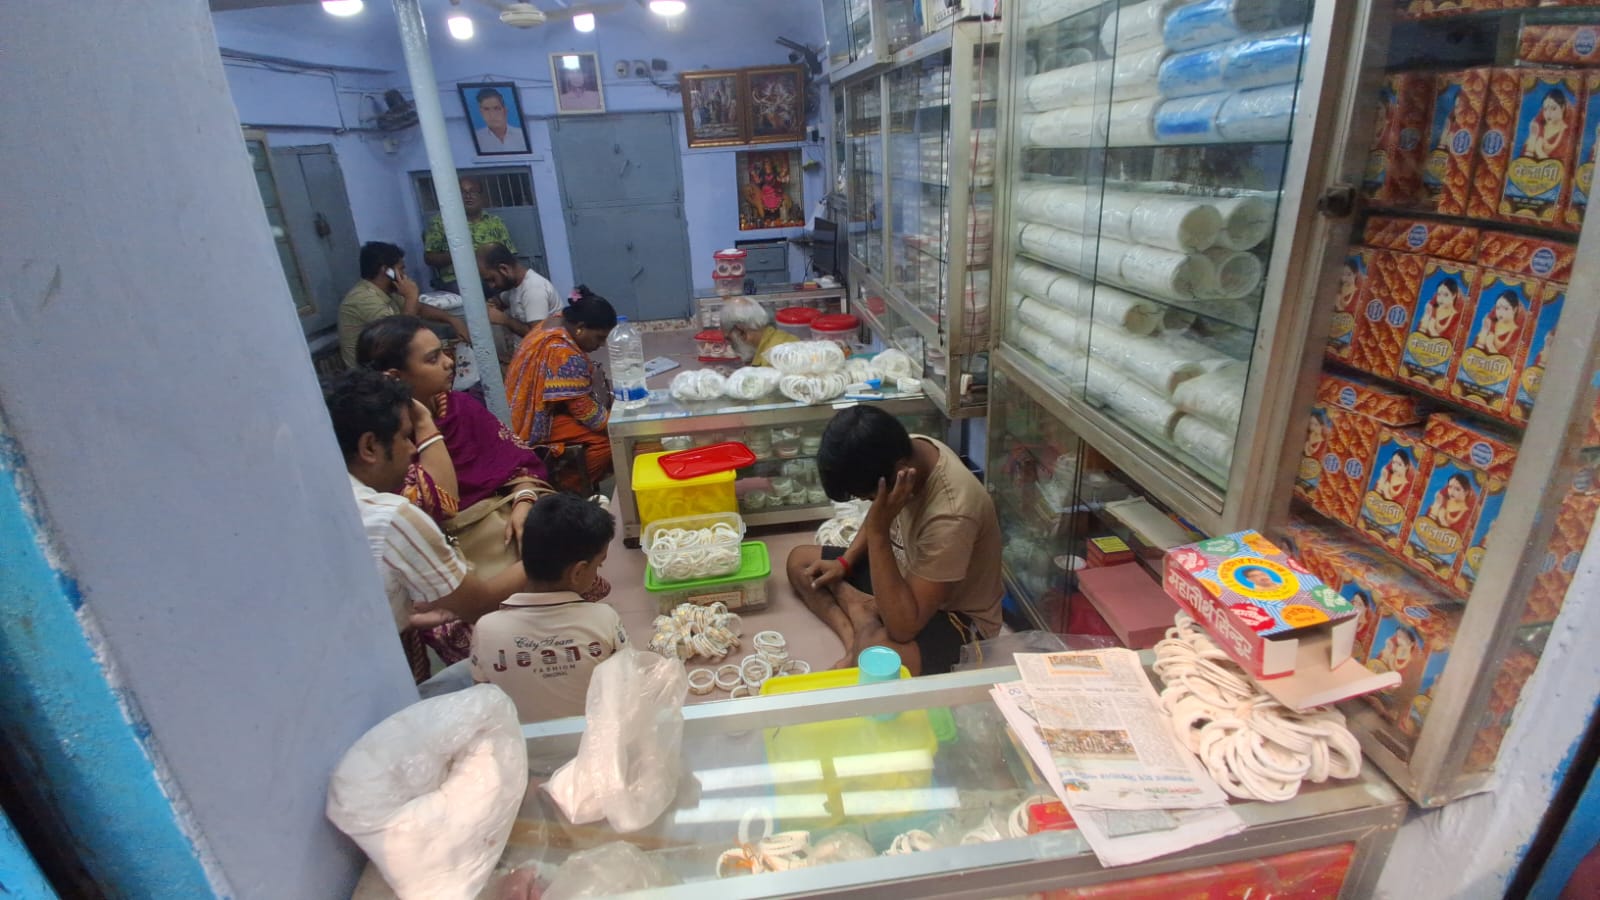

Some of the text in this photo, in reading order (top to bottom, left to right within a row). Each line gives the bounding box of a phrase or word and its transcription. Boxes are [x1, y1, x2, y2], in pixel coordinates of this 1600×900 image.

[1167, 569, 1217, 622] महातीर्थ
[513, 636, 575, 651] City Team
[533, 663, 576, 674] FASHION
